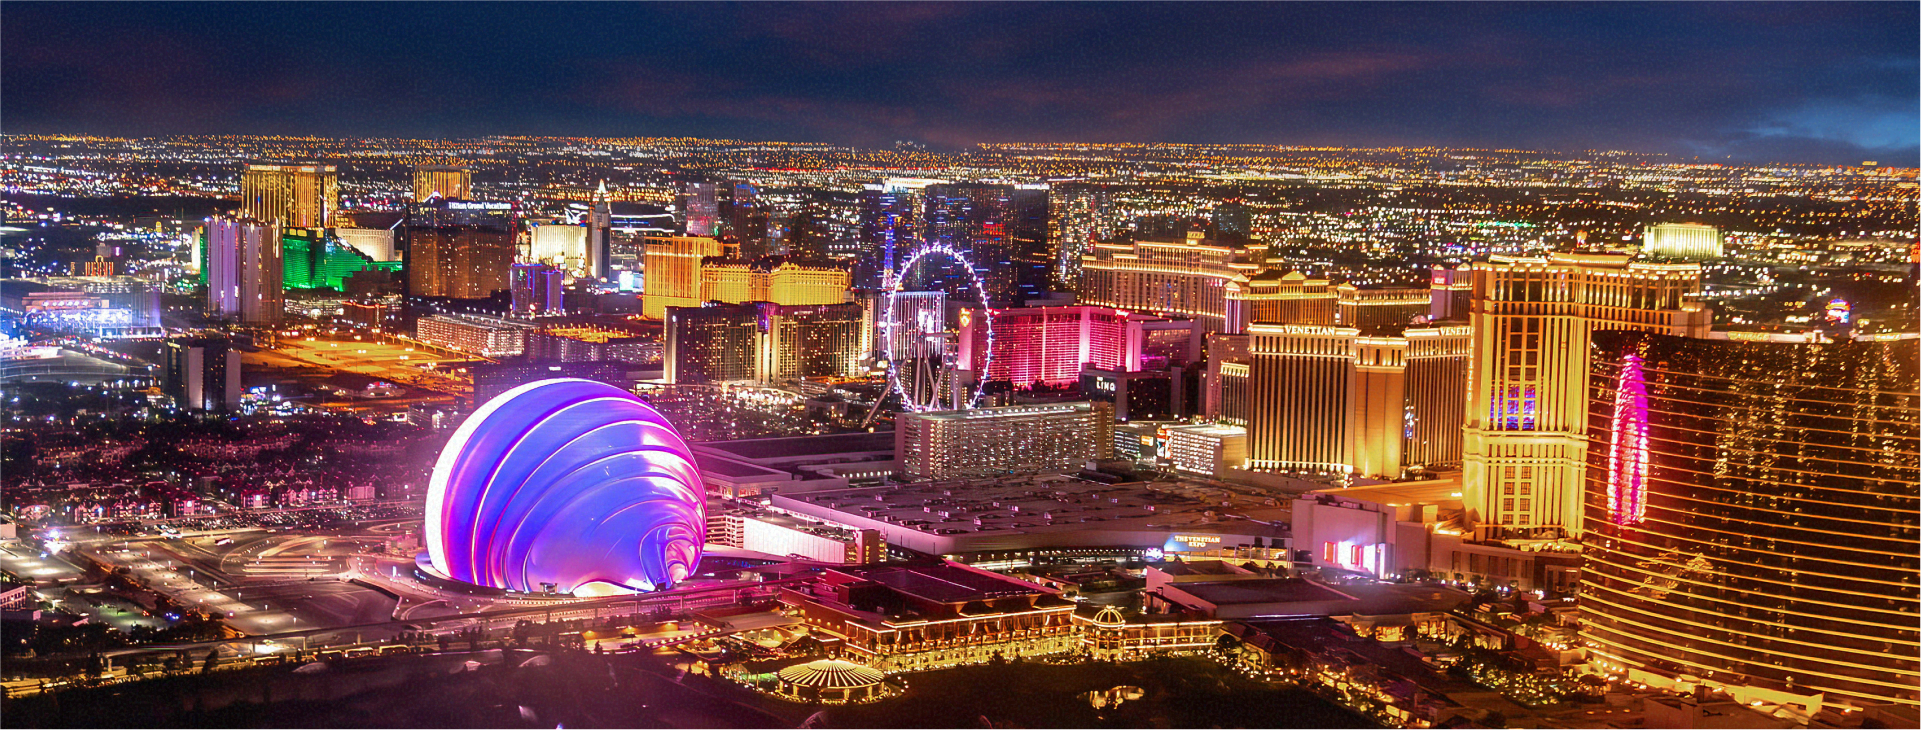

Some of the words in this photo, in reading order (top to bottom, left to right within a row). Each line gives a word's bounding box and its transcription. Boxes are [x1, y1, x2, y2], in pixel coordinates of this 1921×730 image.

[448, 201, 467, 210] Hilton
[467, 201, 485, 210] Grand
[485, 201, 511, 210] Vacations
[1285, 325, 1335, 336] VENETIAN
[1440, 326, 1471, 336] VENETI
[1467, 326, 1475, 402] PALAZZO
[1096, 381, 1116, 391] LINQ
